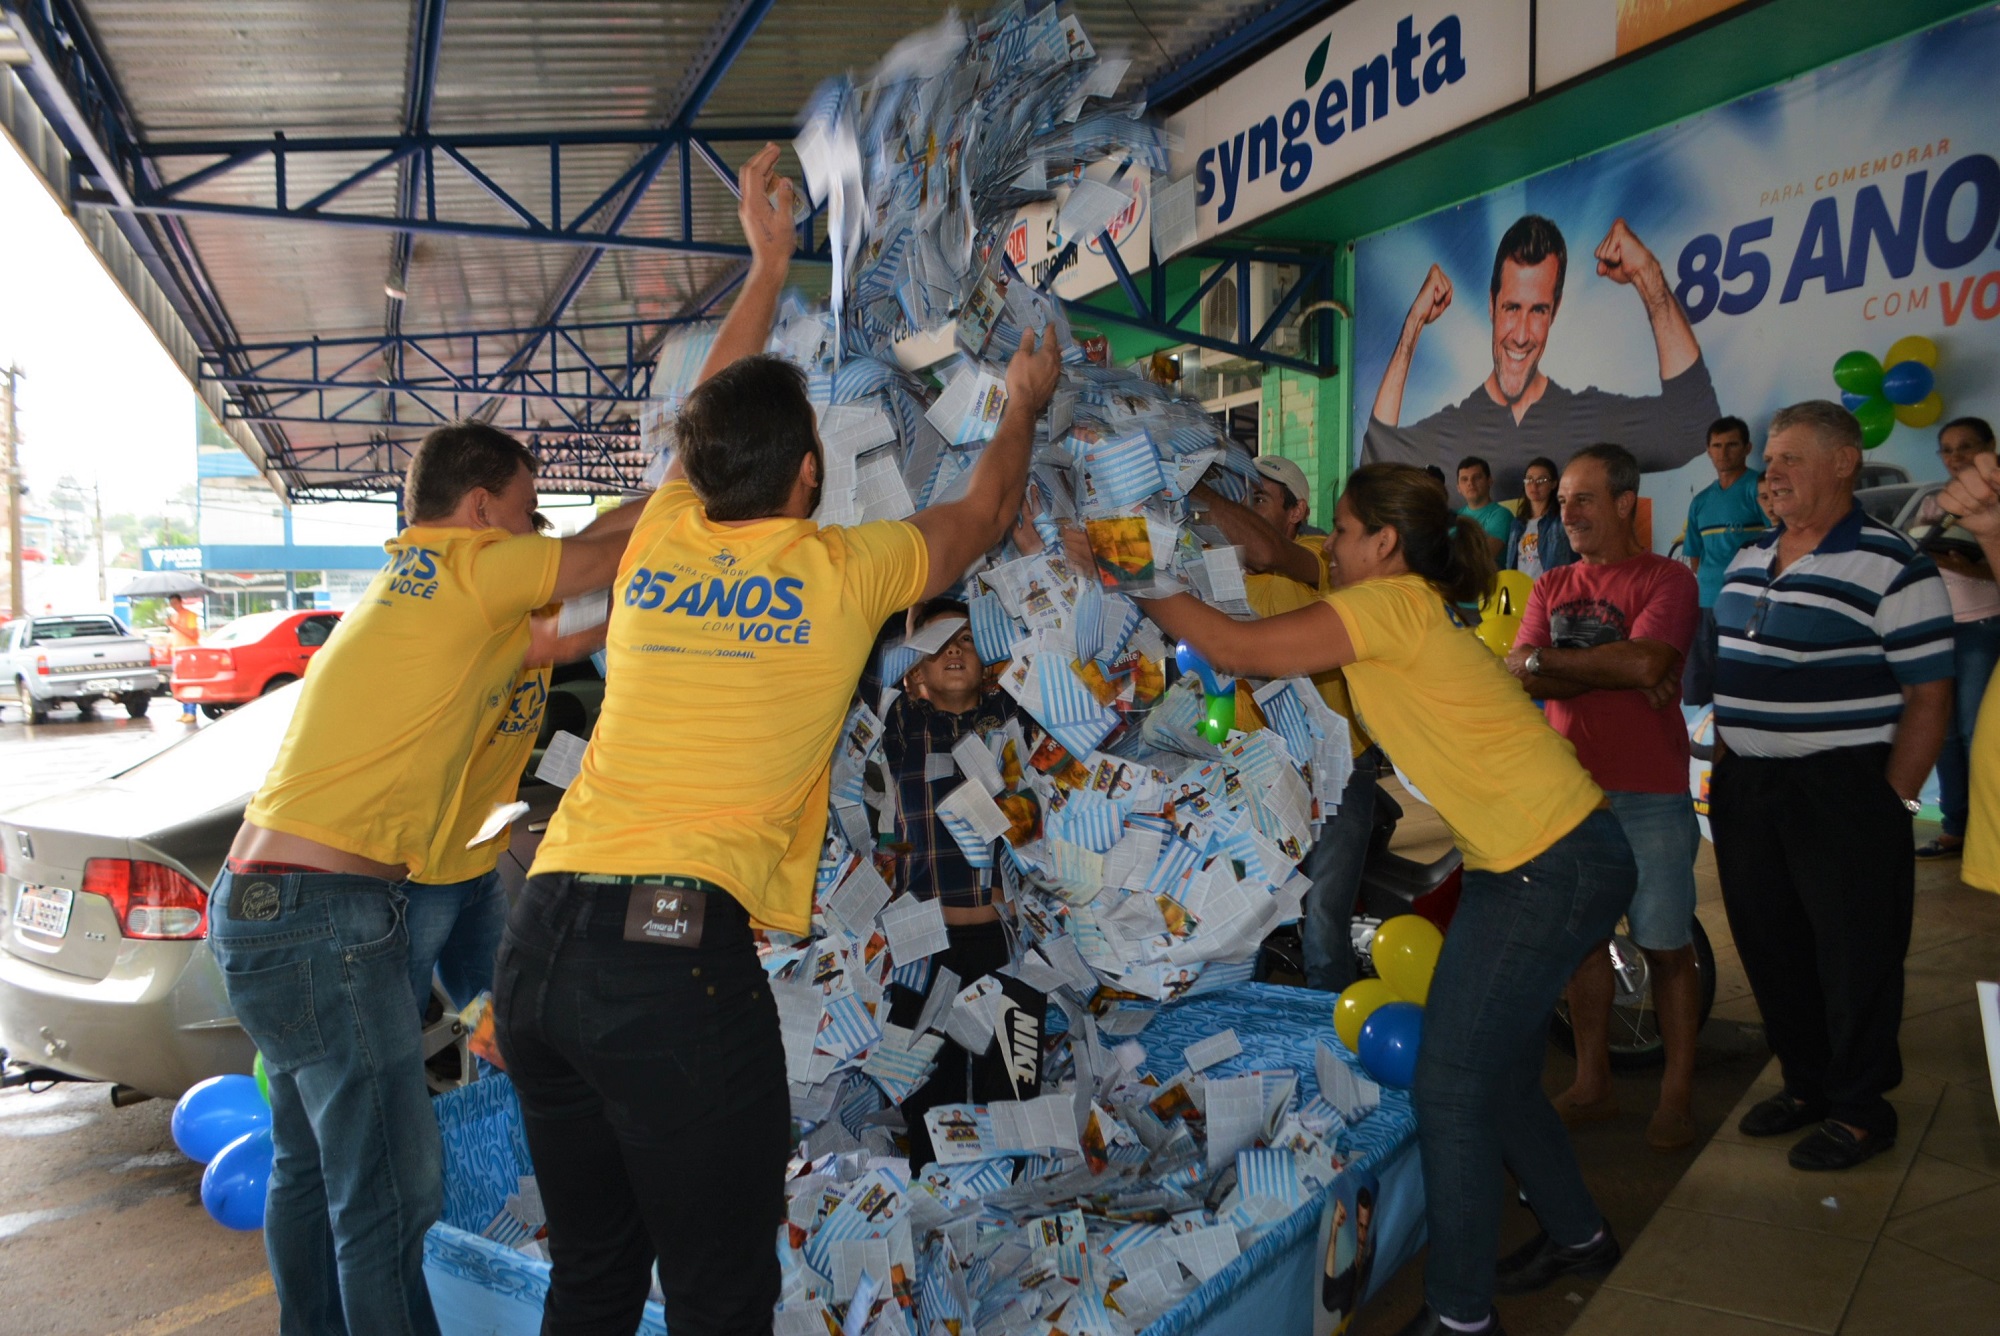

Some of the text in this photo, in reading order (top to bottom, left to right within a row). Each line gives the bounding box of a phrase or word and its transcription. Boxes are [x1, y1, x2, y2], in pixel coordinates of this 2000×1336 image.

[1195, 13, 1467, 224] syngenta
[1759, 137, 1951, 208] PARA COMEMORAR
[1673, 153, 2000, 325] 85 ANO
[1862, 270, 2000, 327] COM VO
[389, 578, 439, 600] VOCÊ
[624, 566, 805, 621] 85 ANOS
[672, 562, 698, 576] PARA
[701, 618, 812, 645] COM VOCÊ
[55, 660, 146, 674] CHEVROLET
[656, 898, 678, 914] 94
[1013, 1008, 1039, 1087] NIKE
